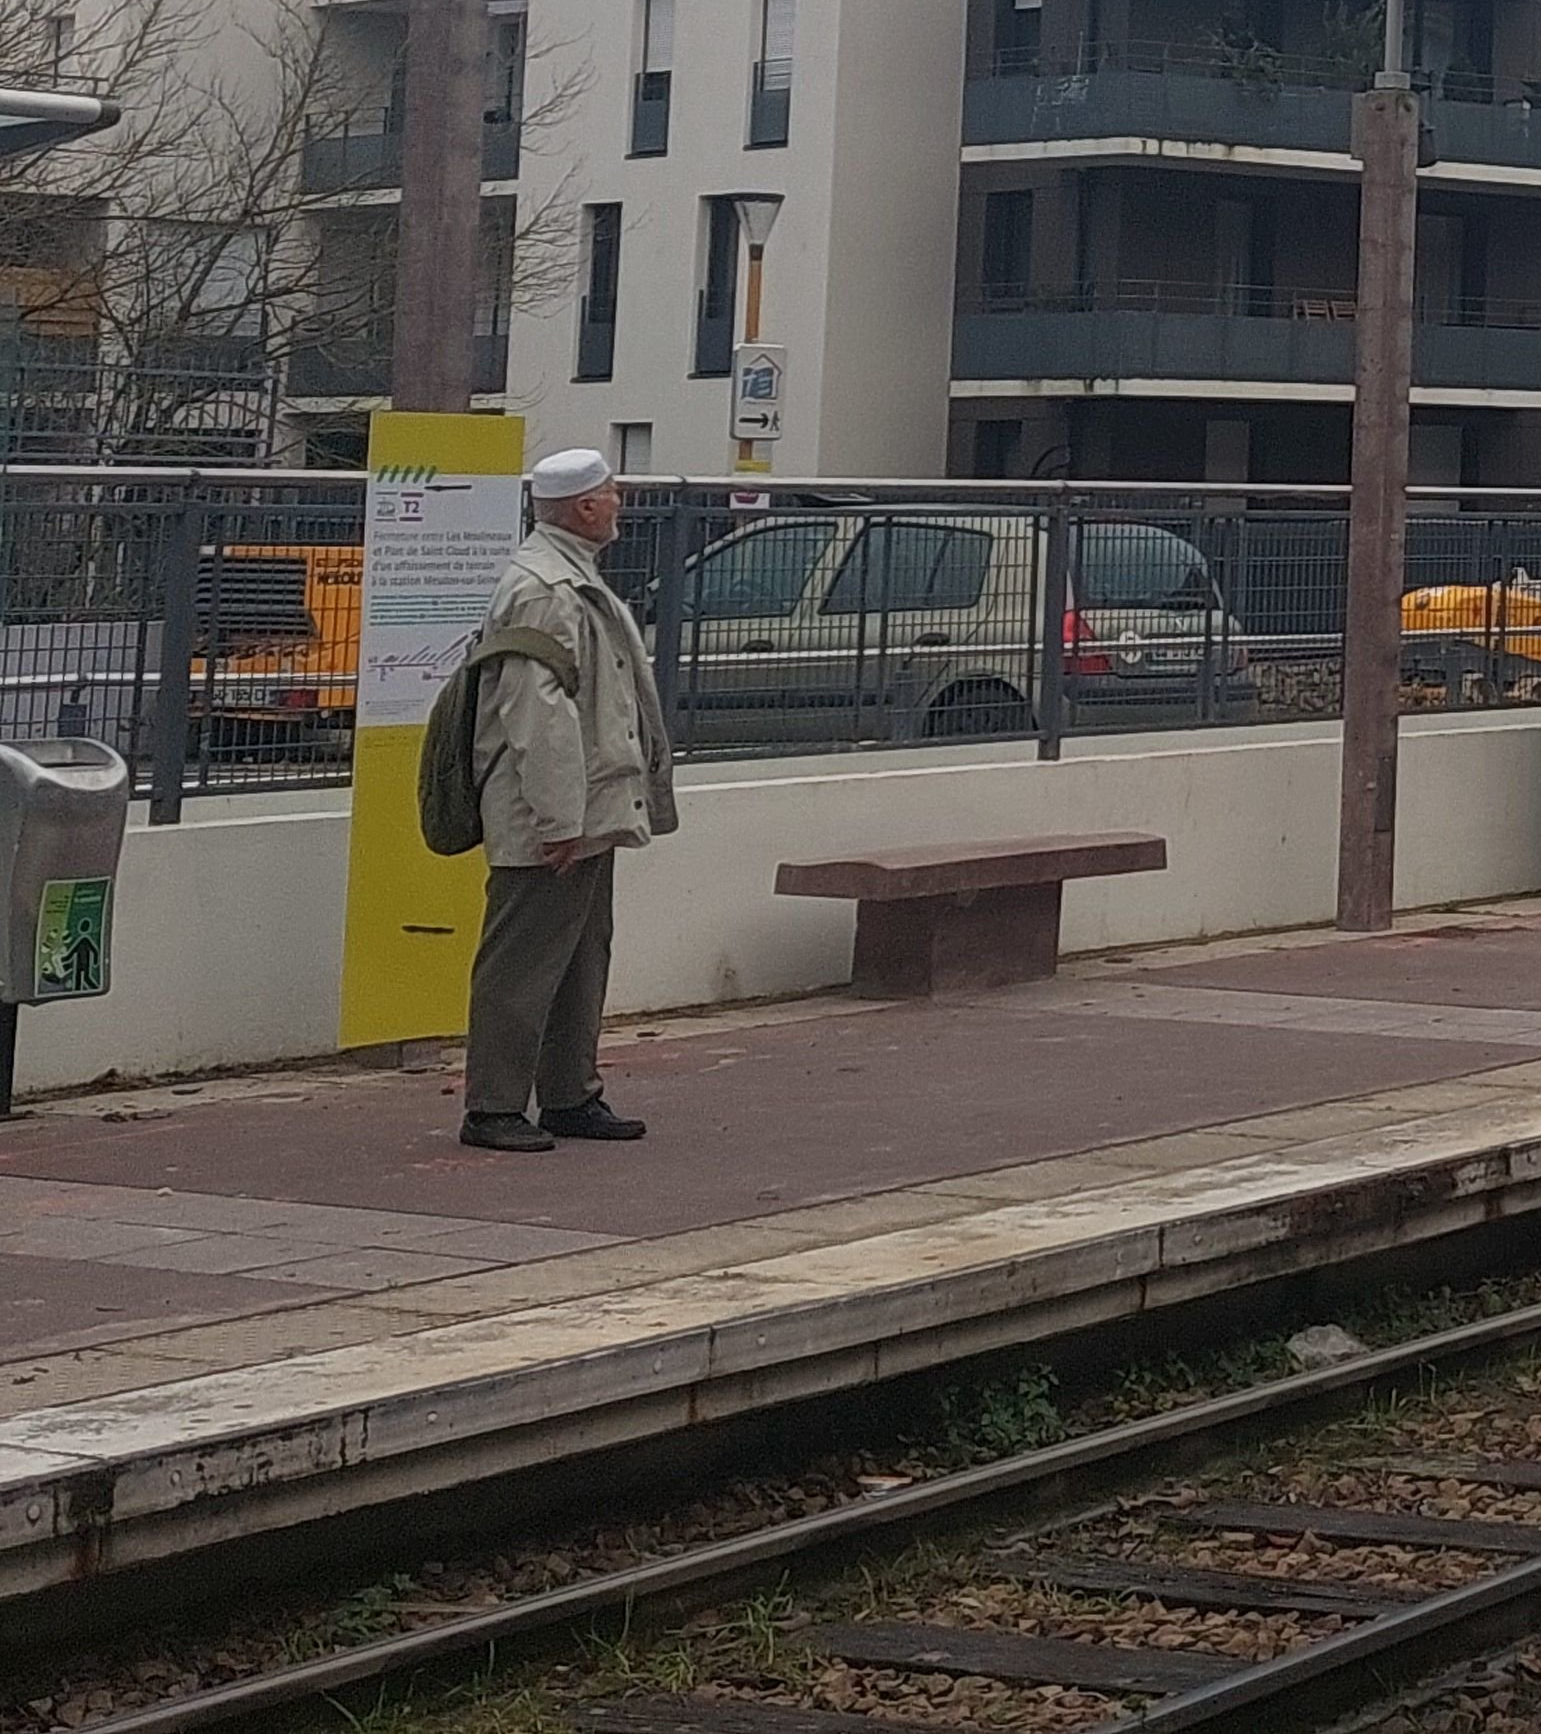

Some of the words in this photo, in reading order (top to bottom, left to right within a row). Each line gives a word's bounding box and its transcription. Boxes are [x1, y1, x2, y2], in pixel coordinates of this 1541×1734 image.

[403, 501, 420, 514] T2
[446, 531, 460, 541] Les
[372, 546, 382, 556] et
[390, 575, 421, 585] station
